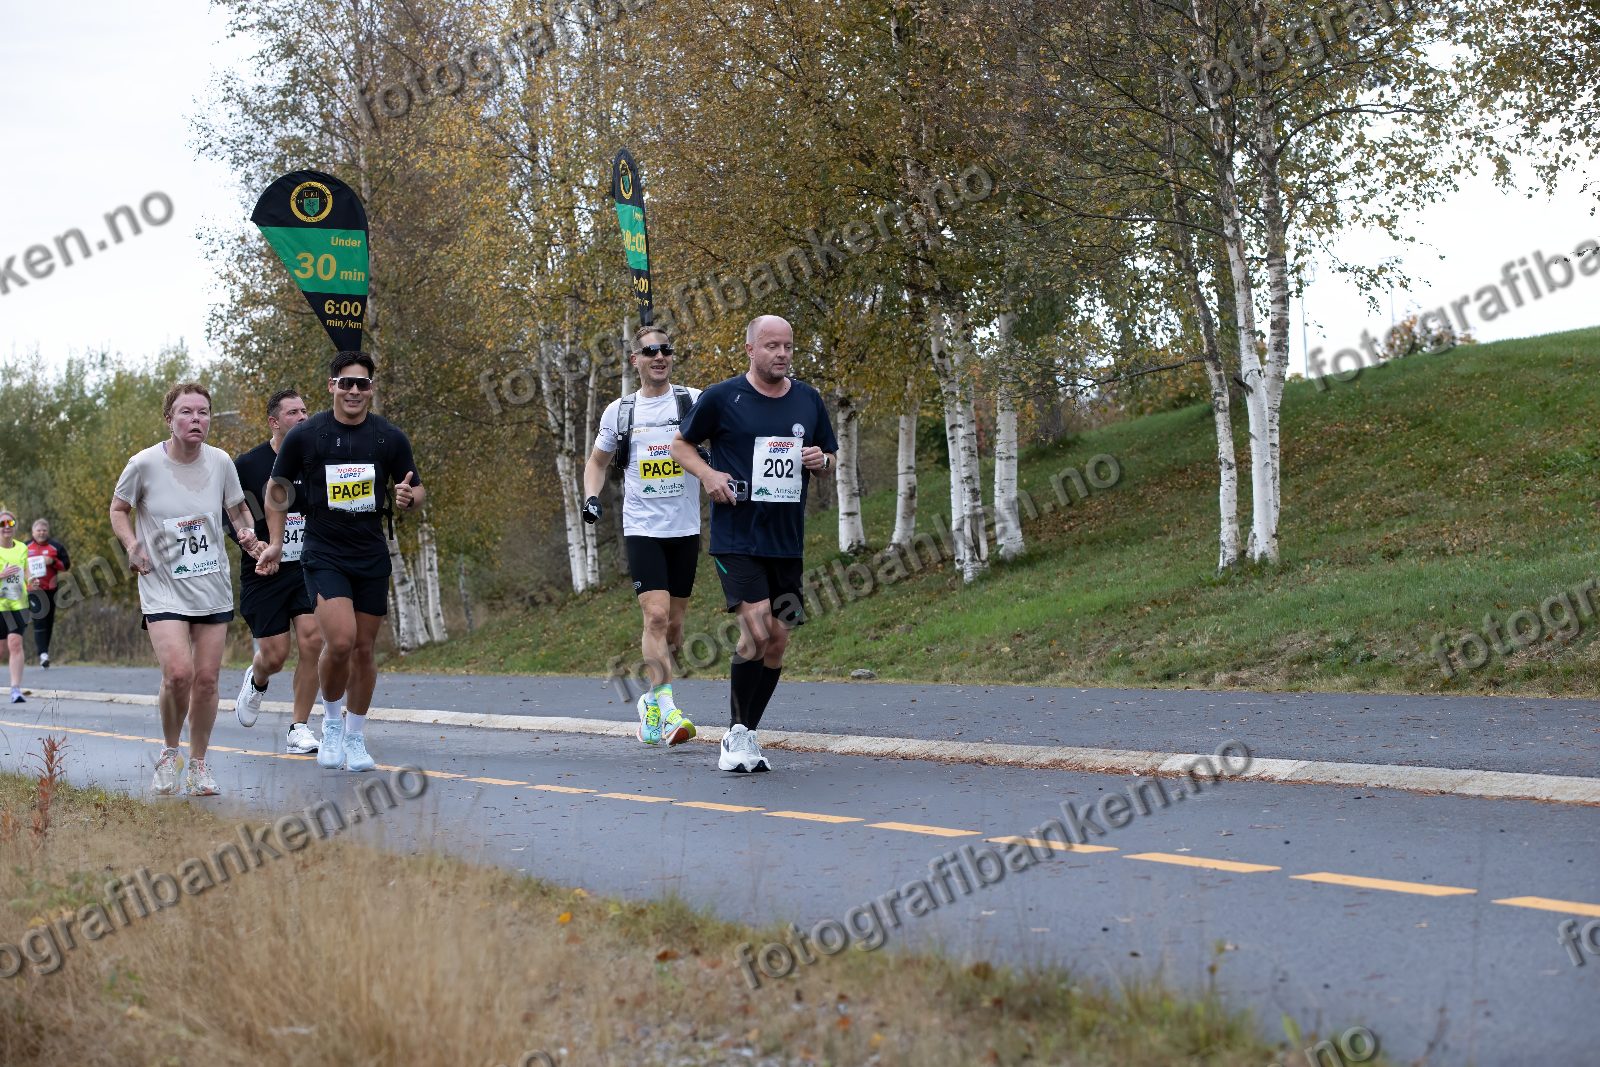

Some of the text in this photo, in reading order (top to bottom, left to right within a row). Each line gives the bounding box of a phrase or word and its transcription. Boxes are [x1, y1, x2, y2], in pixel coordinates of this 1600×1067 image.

[330, 237, 362, 248] Under
[294, 252, 366, 282] 30 min
[324, 299, 362, 317] 6:00
[326, 319, 362, 330] min/km
[642, 461, 682, 477] PACE
[763, 458, 794, 479] 202
[332, 481, 370, 500] PACE
[176, 535, 209, 556] 764
